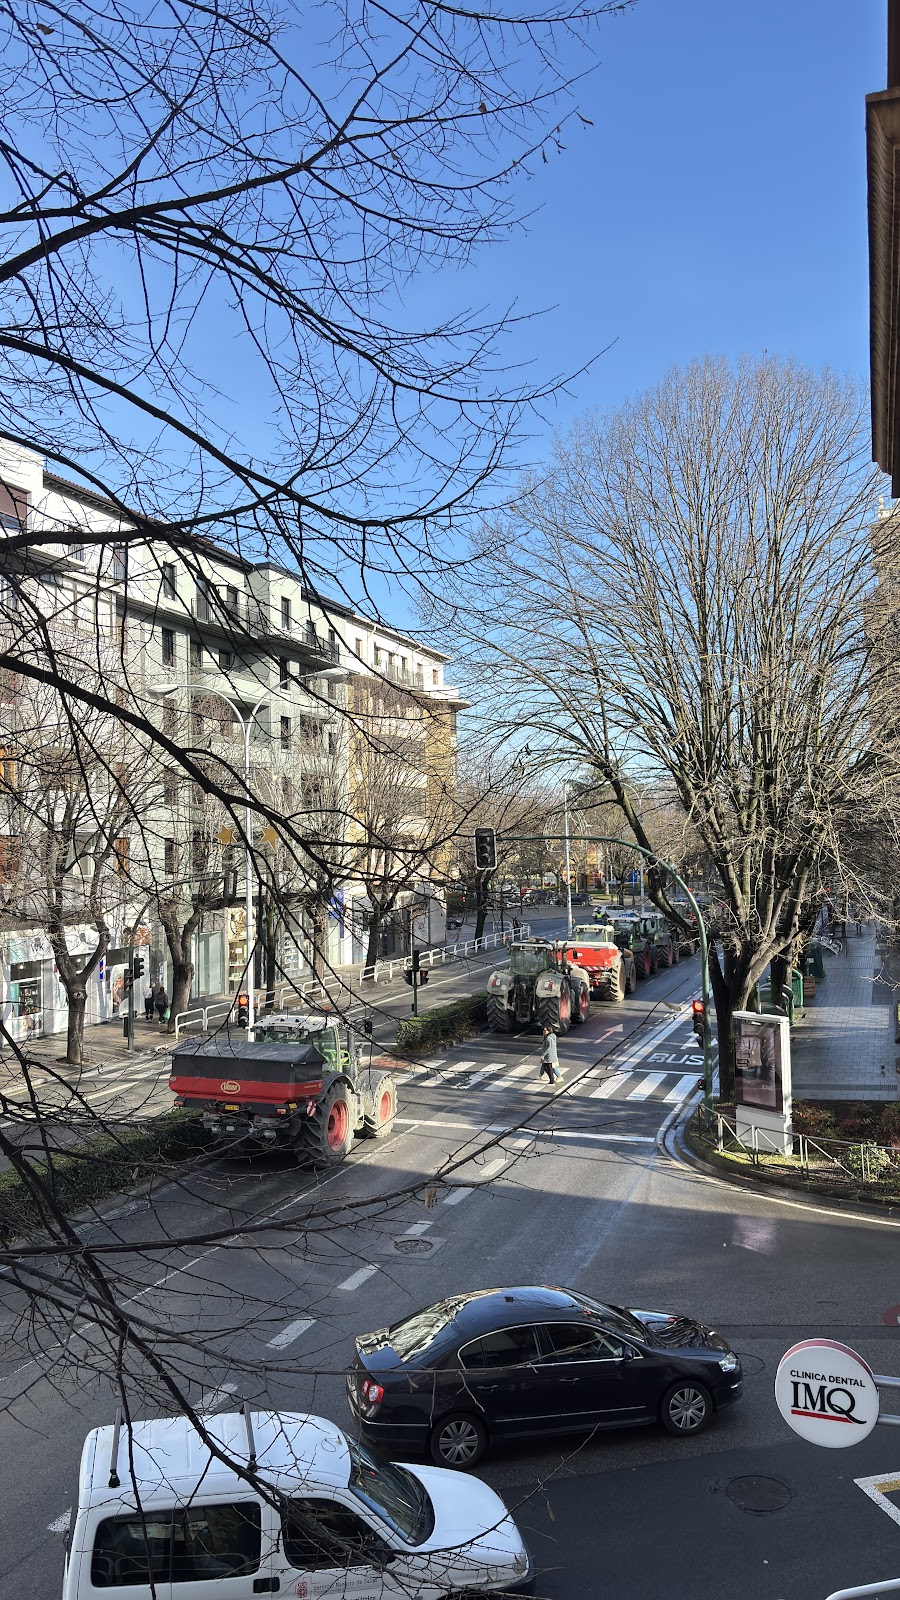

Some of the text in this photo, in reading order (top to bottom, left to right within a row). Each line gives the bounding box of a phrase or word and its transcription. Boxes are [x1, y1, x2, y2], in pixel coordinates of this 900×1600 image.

[646, 1052, 705, 1066] BUS
[790, 1369, 866, 1388] CLINICA DENTAL
[790, 1380, 867, 1425] IMQ
